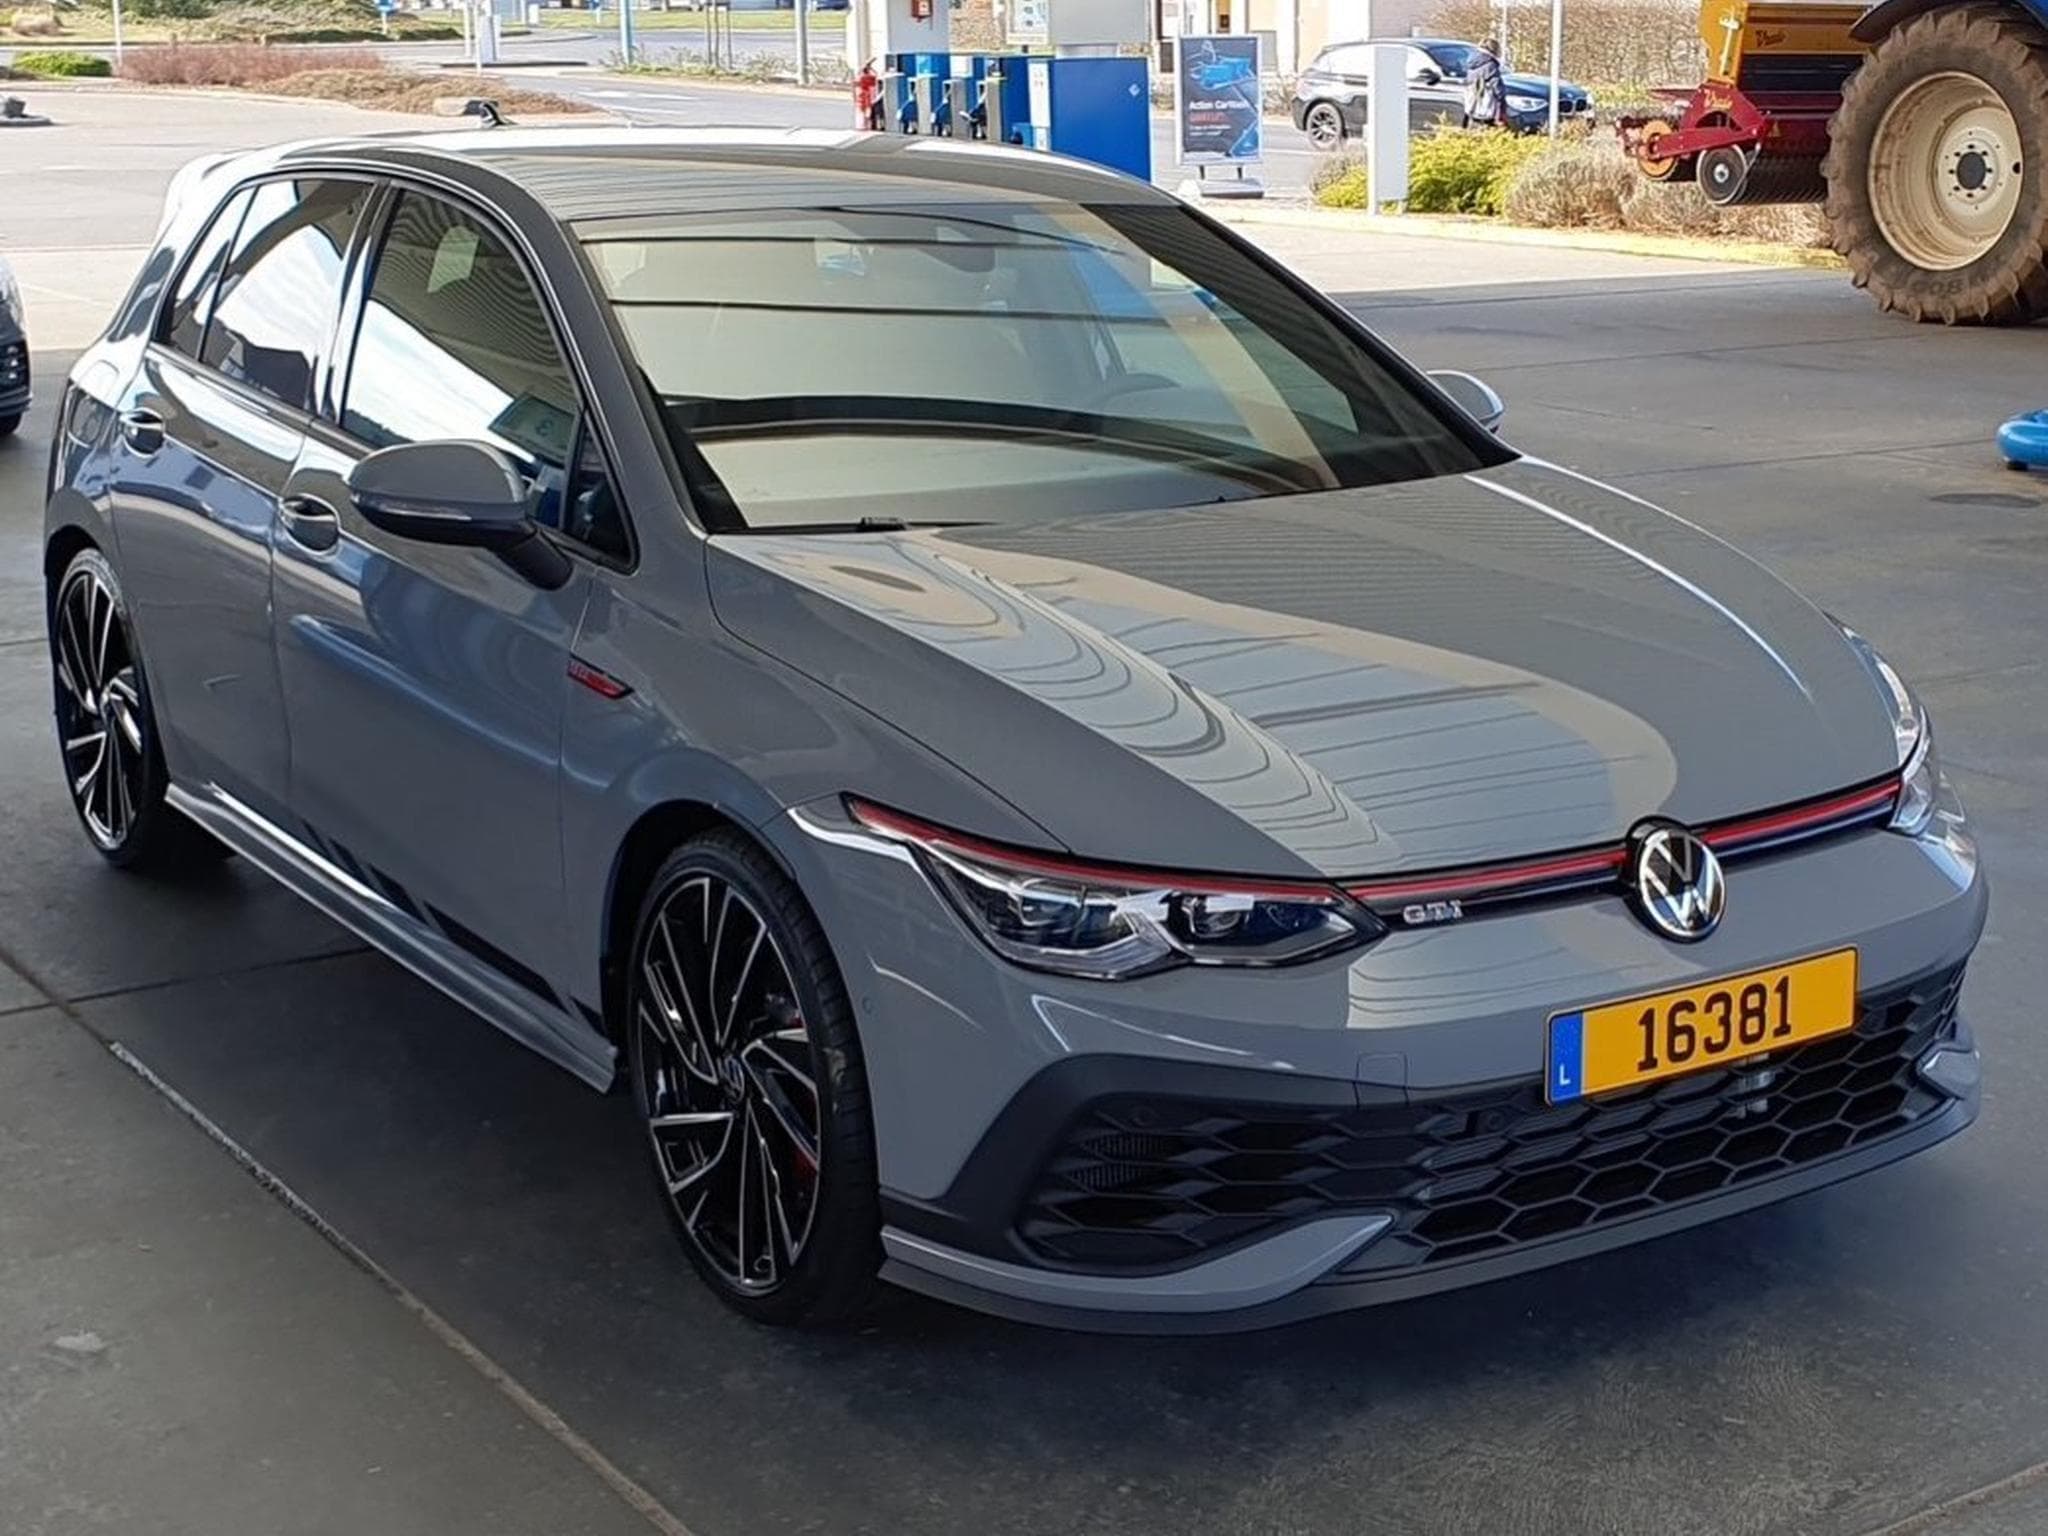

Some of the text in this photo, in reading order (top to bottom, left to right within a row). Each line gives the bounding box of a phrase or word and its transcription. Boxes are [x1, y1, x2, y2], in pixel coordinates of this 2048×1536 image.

[1403, 900, 1463, 924] GTI
[1637, 975, 1792, 1072] 16381
[1558, 1064, 1571, 1086] L
